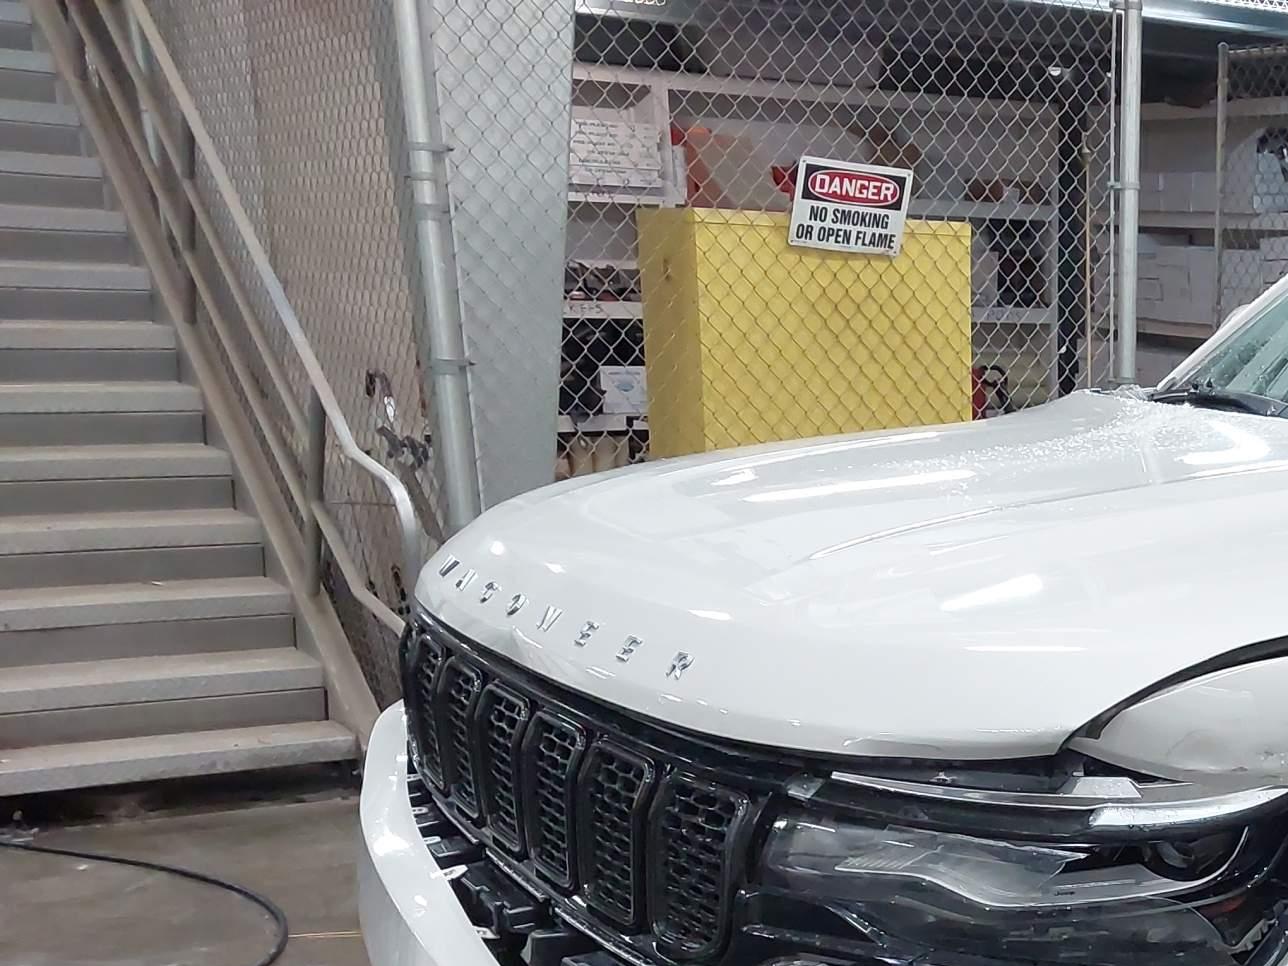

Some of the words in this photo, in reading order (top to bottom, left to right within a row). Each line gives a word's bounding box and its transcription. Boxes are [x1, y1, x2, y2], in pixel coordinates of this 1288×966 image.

[814, 174, 895, 201] DANGER
[808, 205, 829, 223] NO
[831, 208, 890, 230] SMOKING
[795, 223, 814, 241] OR
[817, 226, 852, 246] OPEN
[854, 230, 897, 250] FLAME
